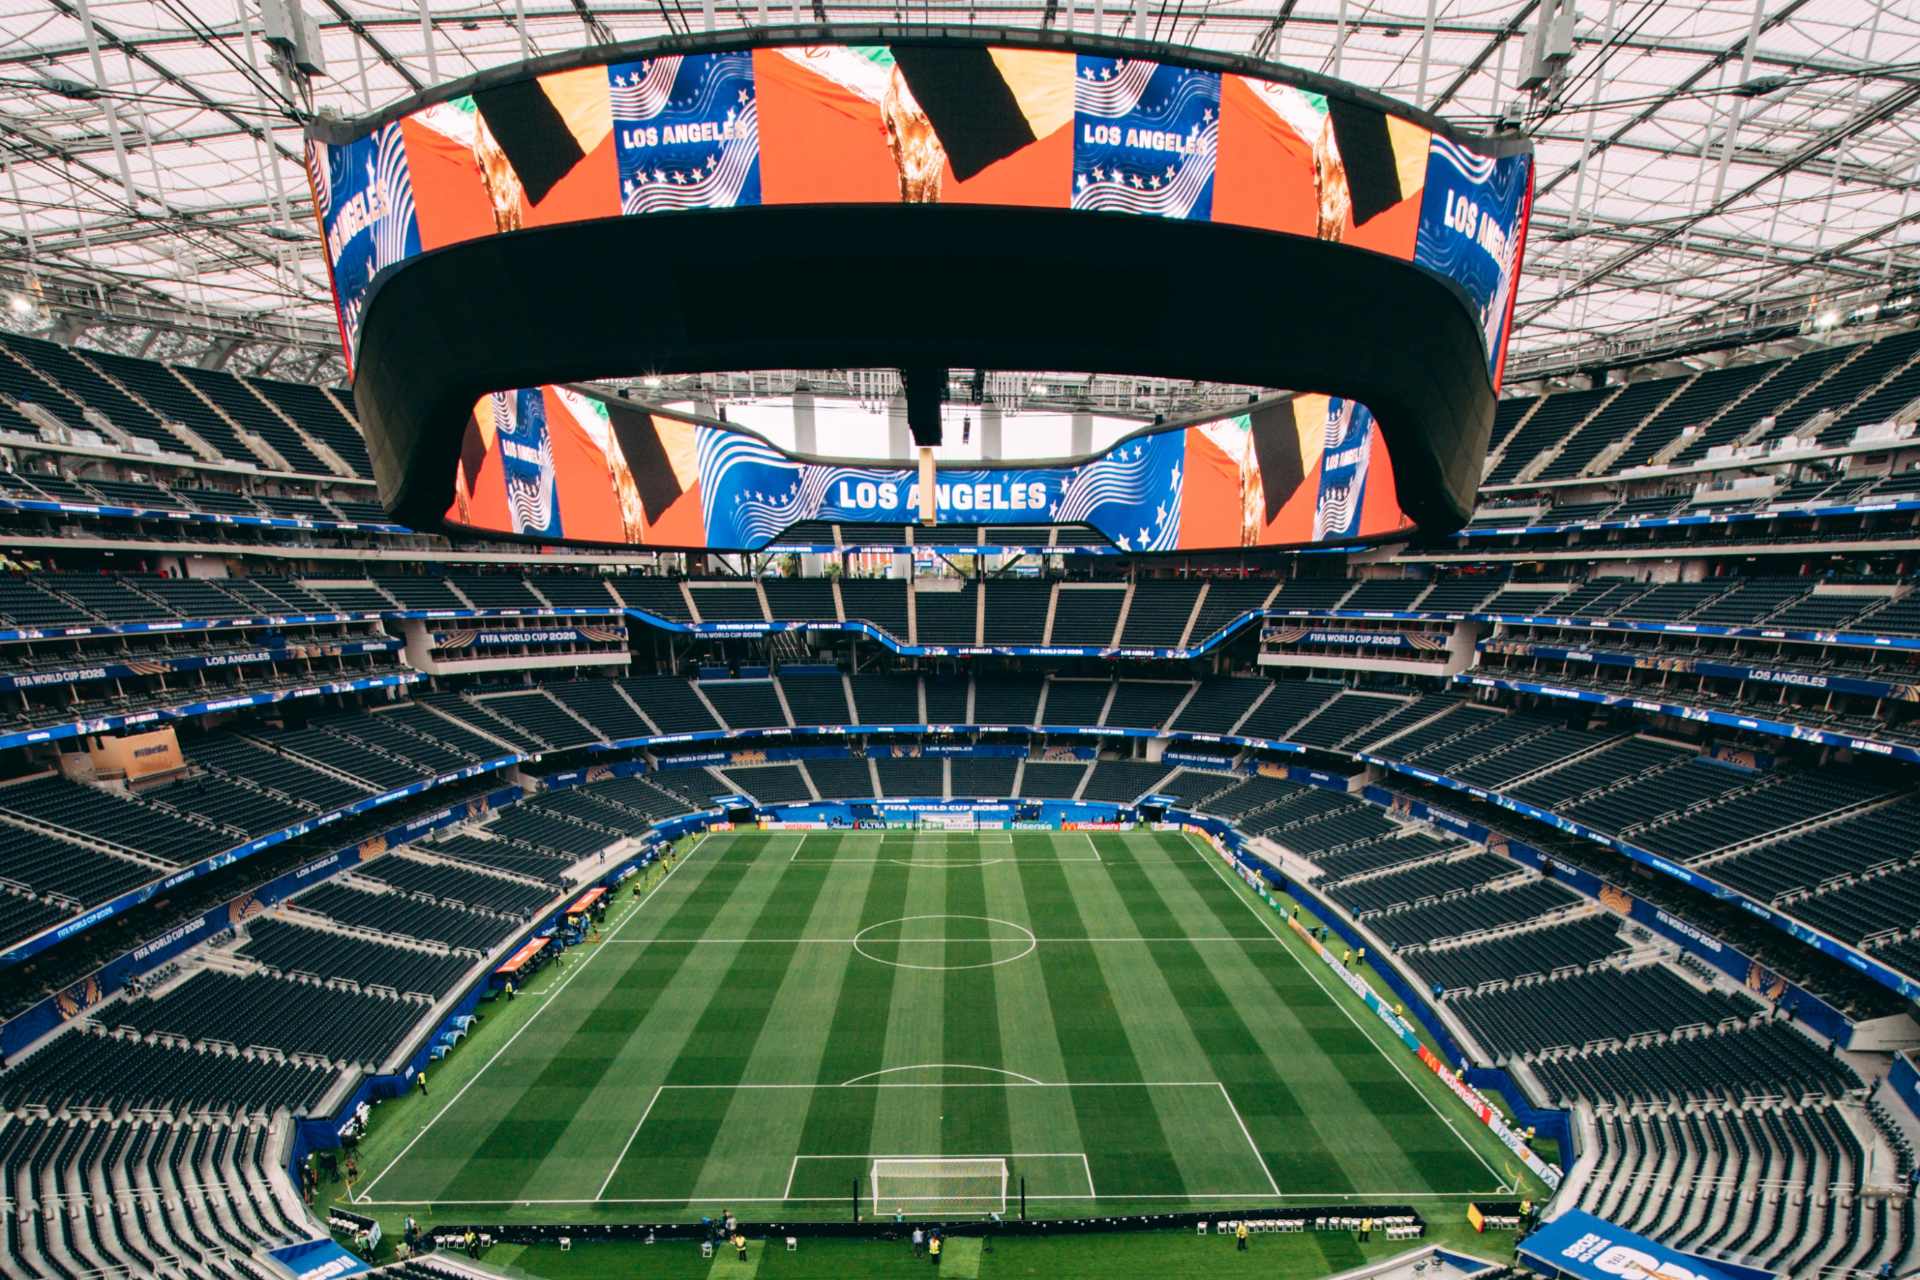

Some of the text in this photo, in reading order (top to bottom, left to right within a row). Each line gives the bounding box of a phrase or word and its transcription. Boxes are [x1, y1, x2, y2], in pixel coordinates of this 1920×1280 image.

[623, 119, 747, 149] LOS ANGELES
[1084, 124, 1208, 155] LOS ANGELES
[1444, 189, 1478, 239] LOS
[840, 481, 1047, 510] LOS ANGELES
[480, 631, 577, 644] FIFA WORLD CUP 2026
[1310, 633, 1400, 645] FIFA WORLD CUP 2026
[205, 652, 271, 666] LOS ANGELES
[13, 669, 106, 688] FIFA WORLD CUP 2026
[1749, 670, 1827, 688] LOS ANGELES
[134, 918, 206, 961] FIFA WORLD CUP 2026
